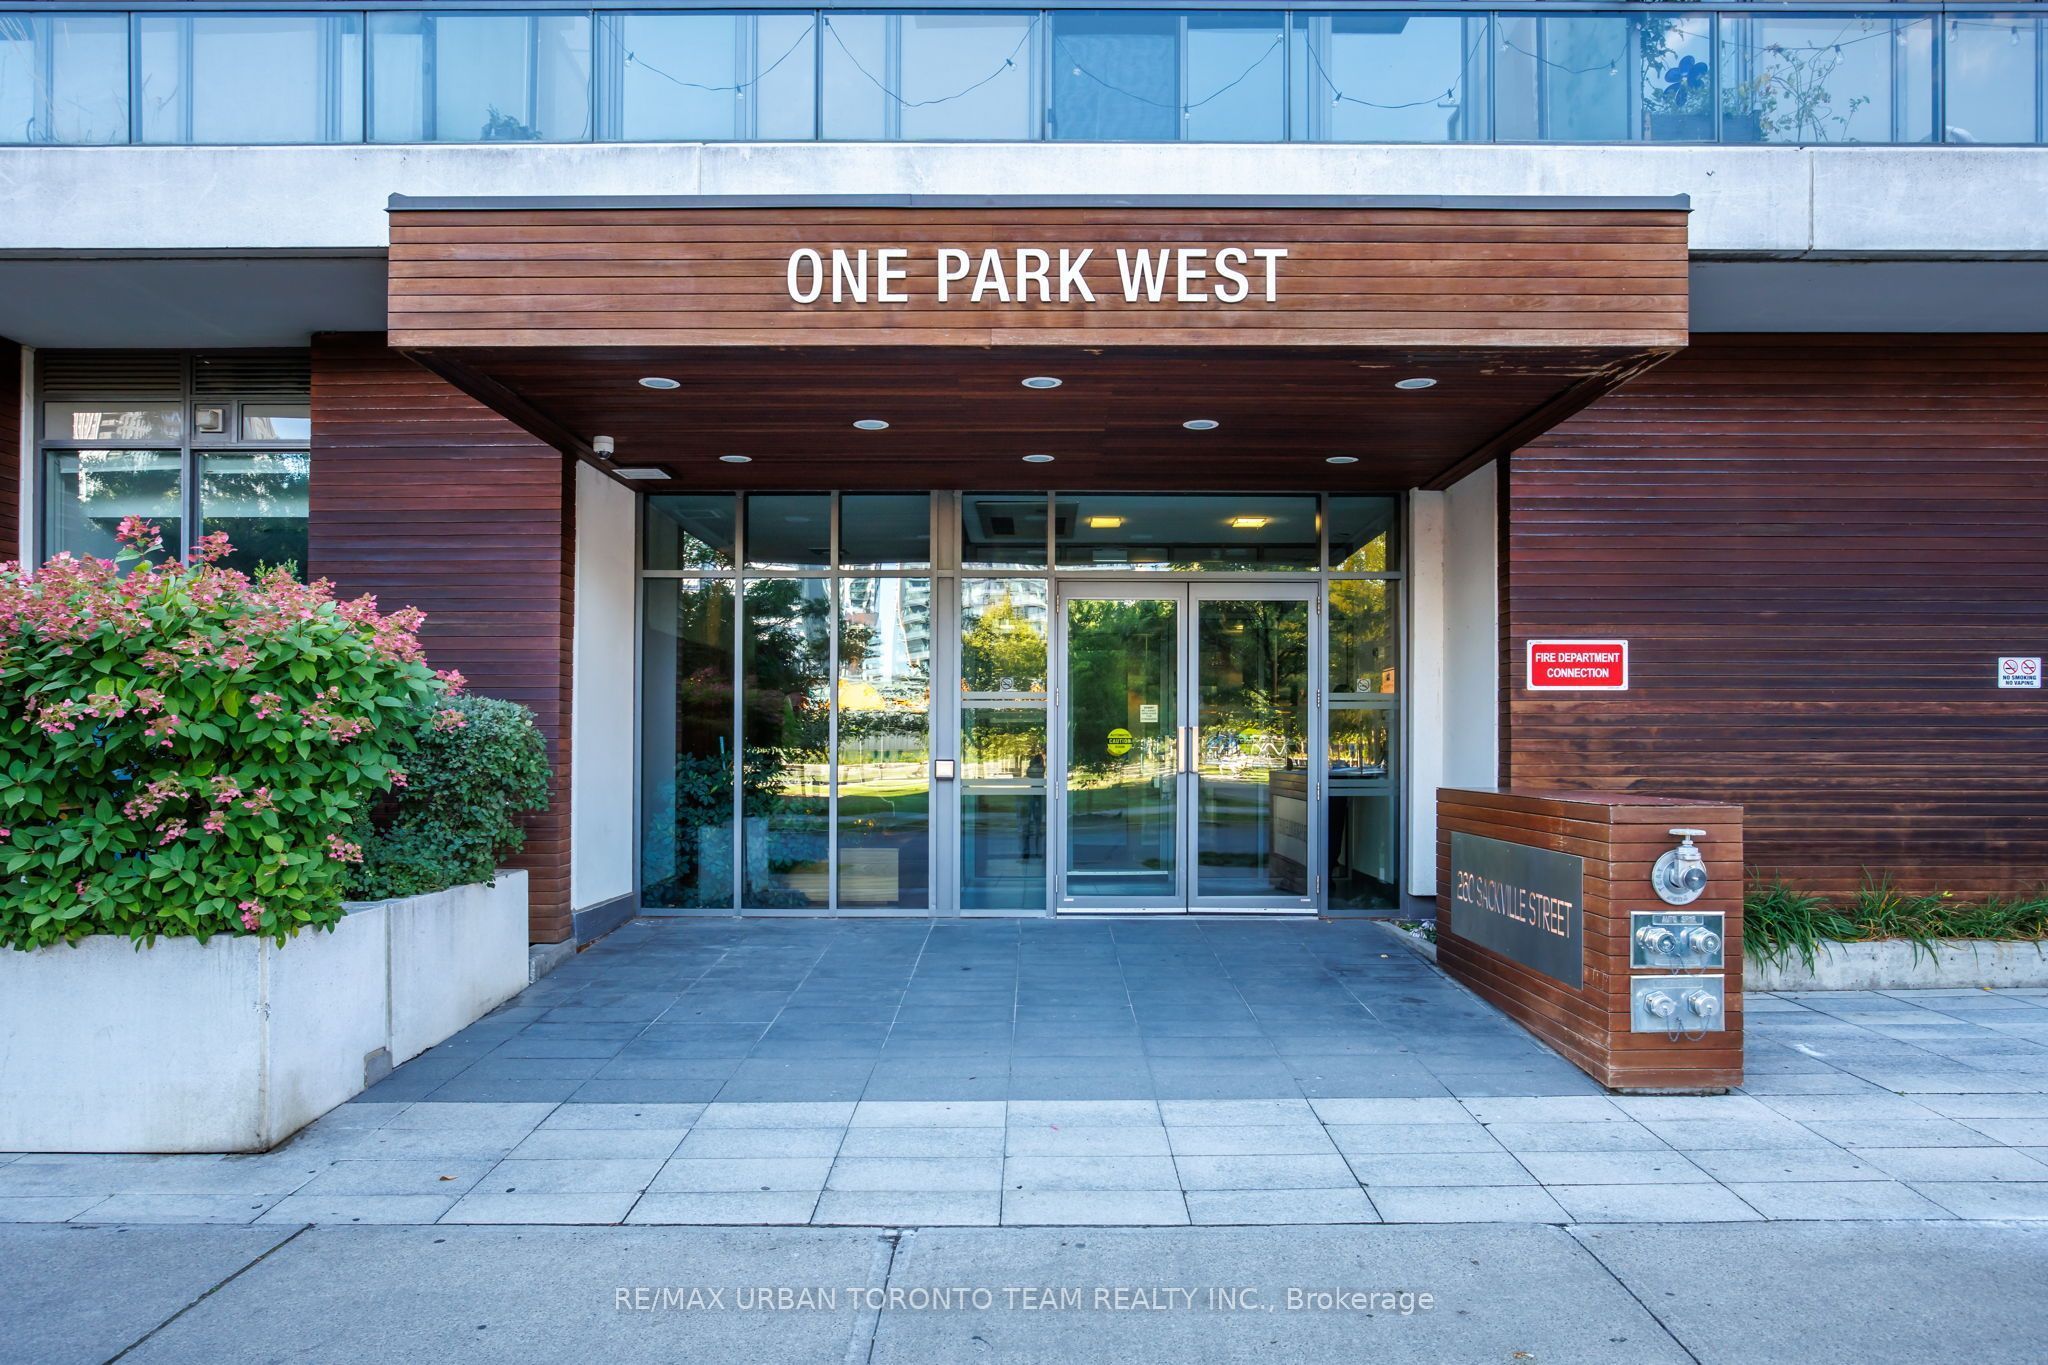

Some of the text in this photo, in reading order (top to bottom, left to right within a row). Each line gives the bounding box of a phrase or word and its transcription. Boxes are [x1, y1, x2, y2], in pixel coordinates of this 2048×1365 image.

[786, 247, 1288, 304] ONE PARK WEST
[1535, 652, 1620, 663] FIRE DEPARTMENT
[1546, 667, 1610, 678] CONNECTION
[1476, 876, 1526, 923] SACKVILLE
[1528, 891, 1573, 938] STREET
